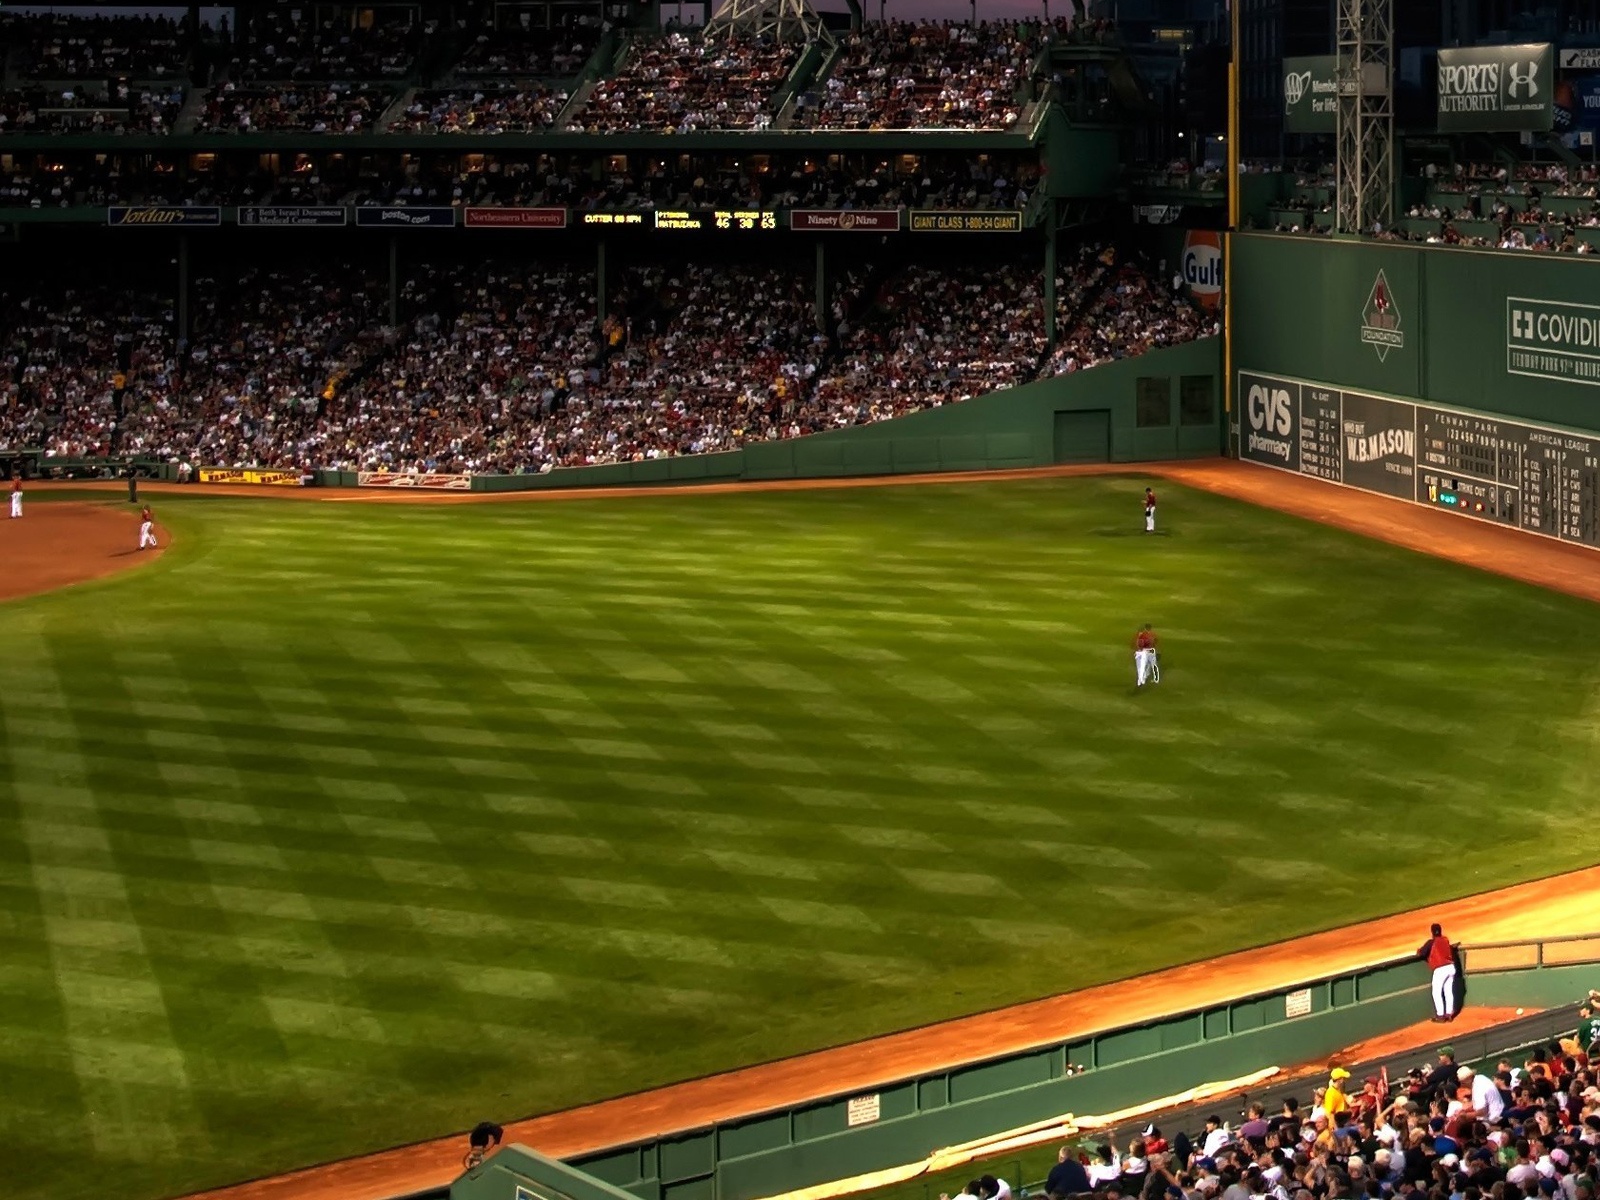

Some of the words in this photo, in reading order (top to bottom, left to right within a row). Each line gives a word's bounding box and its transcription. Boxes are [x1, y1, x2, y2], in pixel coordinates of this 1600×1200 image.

[1438, 63, 1499, 94] SPORTS
[1312, 98, 1324, 112] For
[120, 207, 185, 224] Jordan's
[259, 208, 277, 216] Beth
[279, 208, 300, 216] Israel
[469, 212, 520, 222] Northeastern
[521, 212, 562, 225] University
[584, 213, 613, 224] CUTTER
[259, 216, 289, 224] Medical
[291, 216, 318, 224] Center
[808, 215, 837, 226] Ninety
[855, 214, 877, 225] Nine
[914, 216, 936, 228] GIANT
[937, 216, 963, 229] GLASS
[994, 216, 1016, 229] GIANT
[1363, 330, 1401, 343] FOUNDATION
[1512, 352, 1539, 369] FENWAY
[1540, 356, 1558, 371] PARK
[1248, 384, 1292, 437] CVS
[1355, 423, 1365, 435] BUT
[1435, 413, 1469, 429] FENWAY
[1474, 421, 1498, 434] PARK
[1248, 431, 1292, 462] pharmacy
[1523, 444, 1528, 453] P
[1529, 432, 1562, 447] AMERICAN
[1564, 439, 1590, 453] LEAGUE
[1385, 462, 1400, 474] SINCE
[1593, 457, 1598, 468] R
[1570, 469, 1580, 479] PIT
[1457, 482, 1474, 495] STRIKE
[1474, 486, 1486, 497] OUT
[1571, 515, 1579, 526] SF
[1570, 526, 1580, 537] SEA
